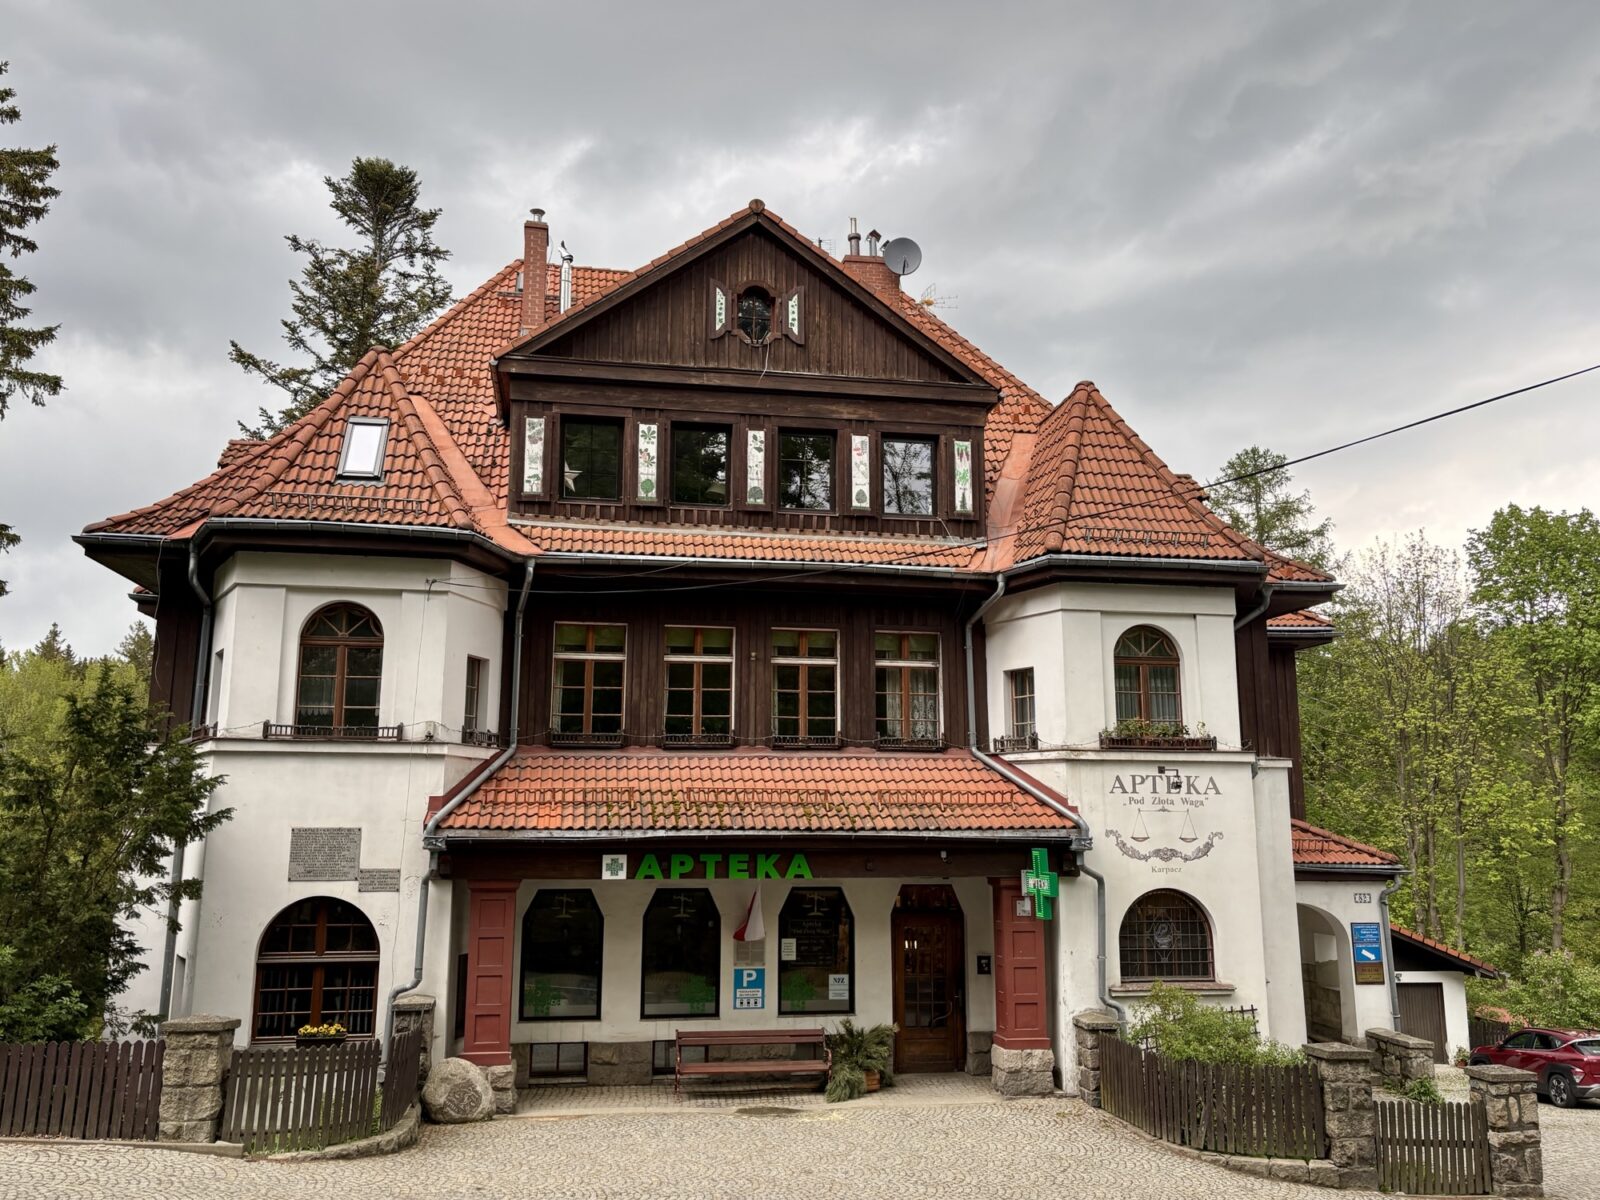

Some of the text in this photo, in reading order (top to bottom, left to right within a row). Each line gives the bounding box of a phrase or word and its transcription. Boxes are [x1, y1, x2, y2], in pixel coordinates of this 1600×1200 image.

[1109, 774, 1222, 795] APTEKA
[635, 853, 814, 880] APTEKA
[1151, 866, 1182, 875] Karpacz
[743, 970, 757, 988] P
